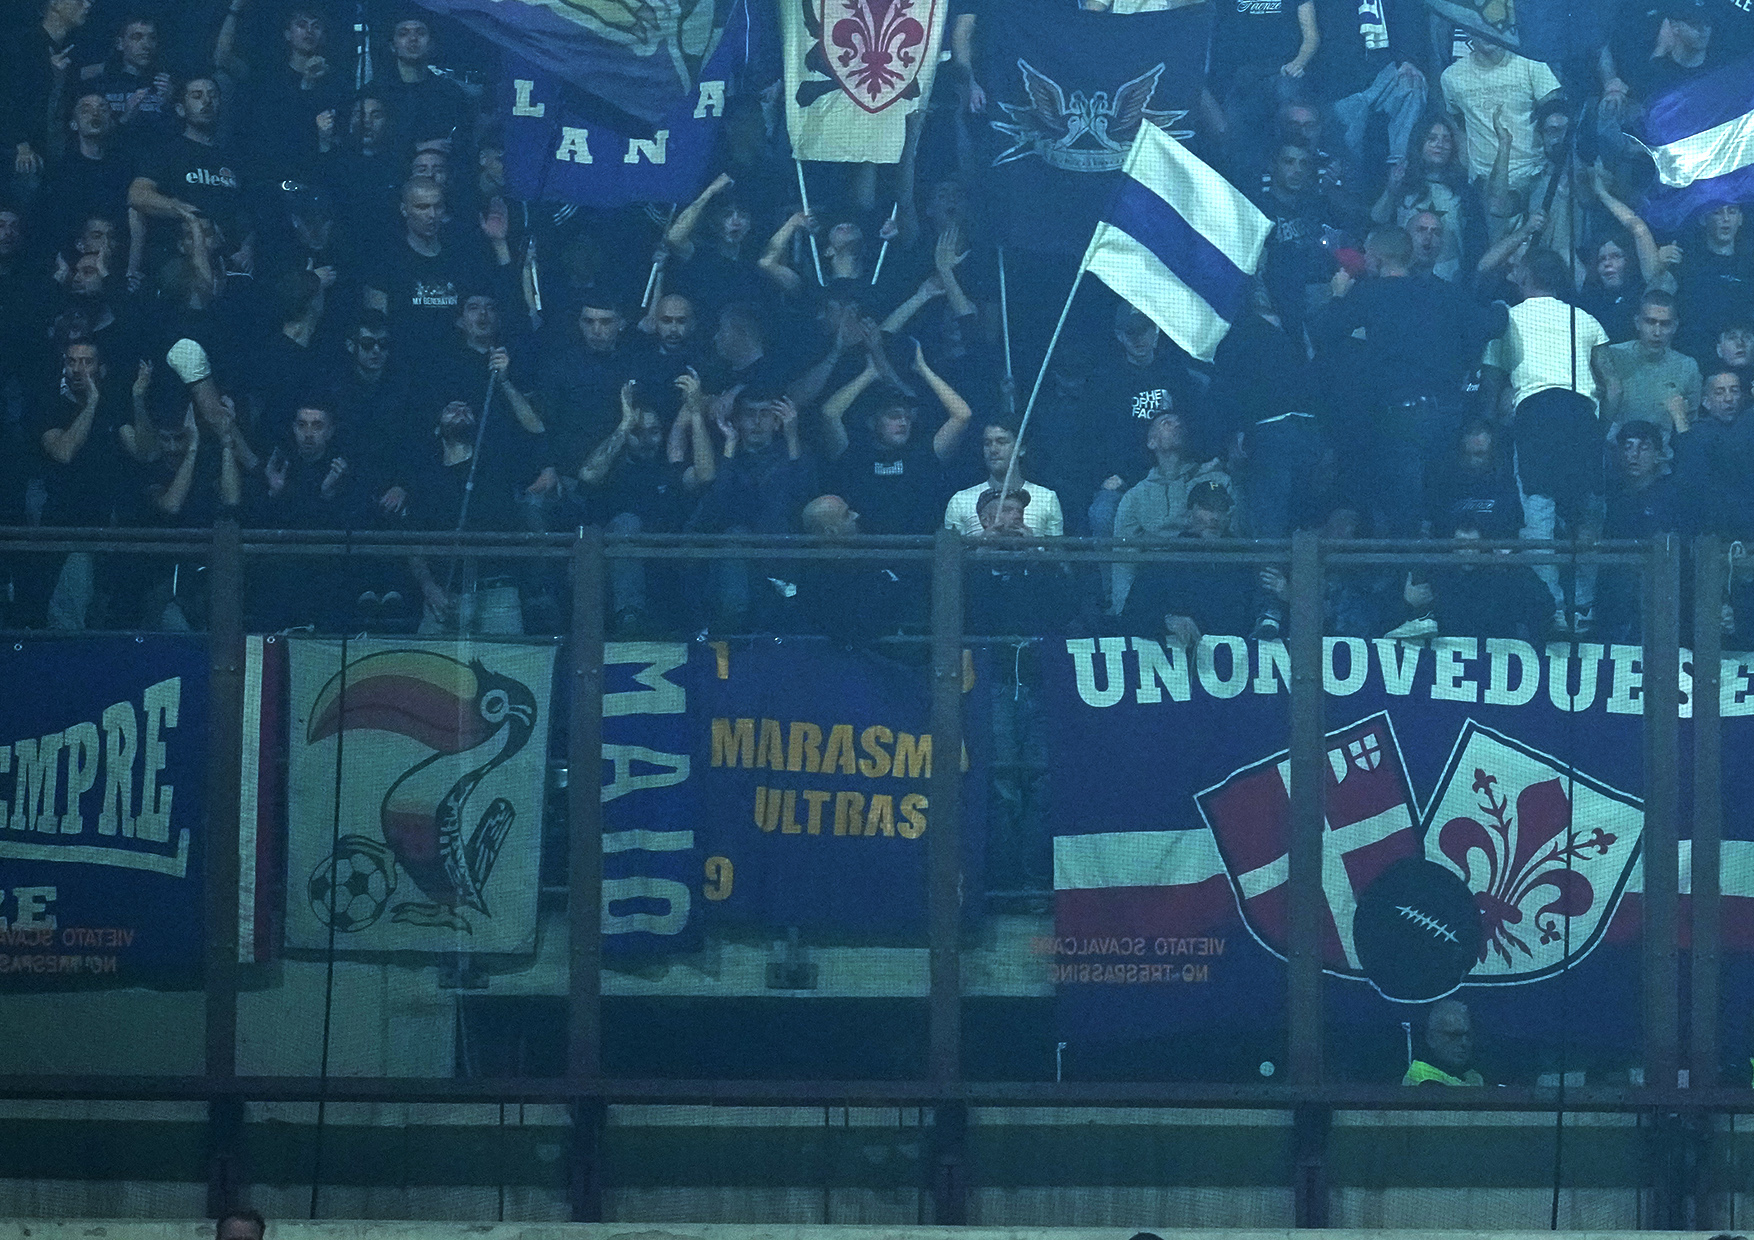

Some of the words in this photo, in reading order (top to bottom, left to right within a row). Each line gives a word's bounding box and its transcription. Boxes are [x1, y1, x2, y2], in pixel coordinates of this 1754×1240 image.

[1139, 389, 1162, 401] THE
[1132, 406, 1155, 420] FAC
[711, 716, 968, 779] MARASM
[754, 785, 930, 839] ULTRAS
